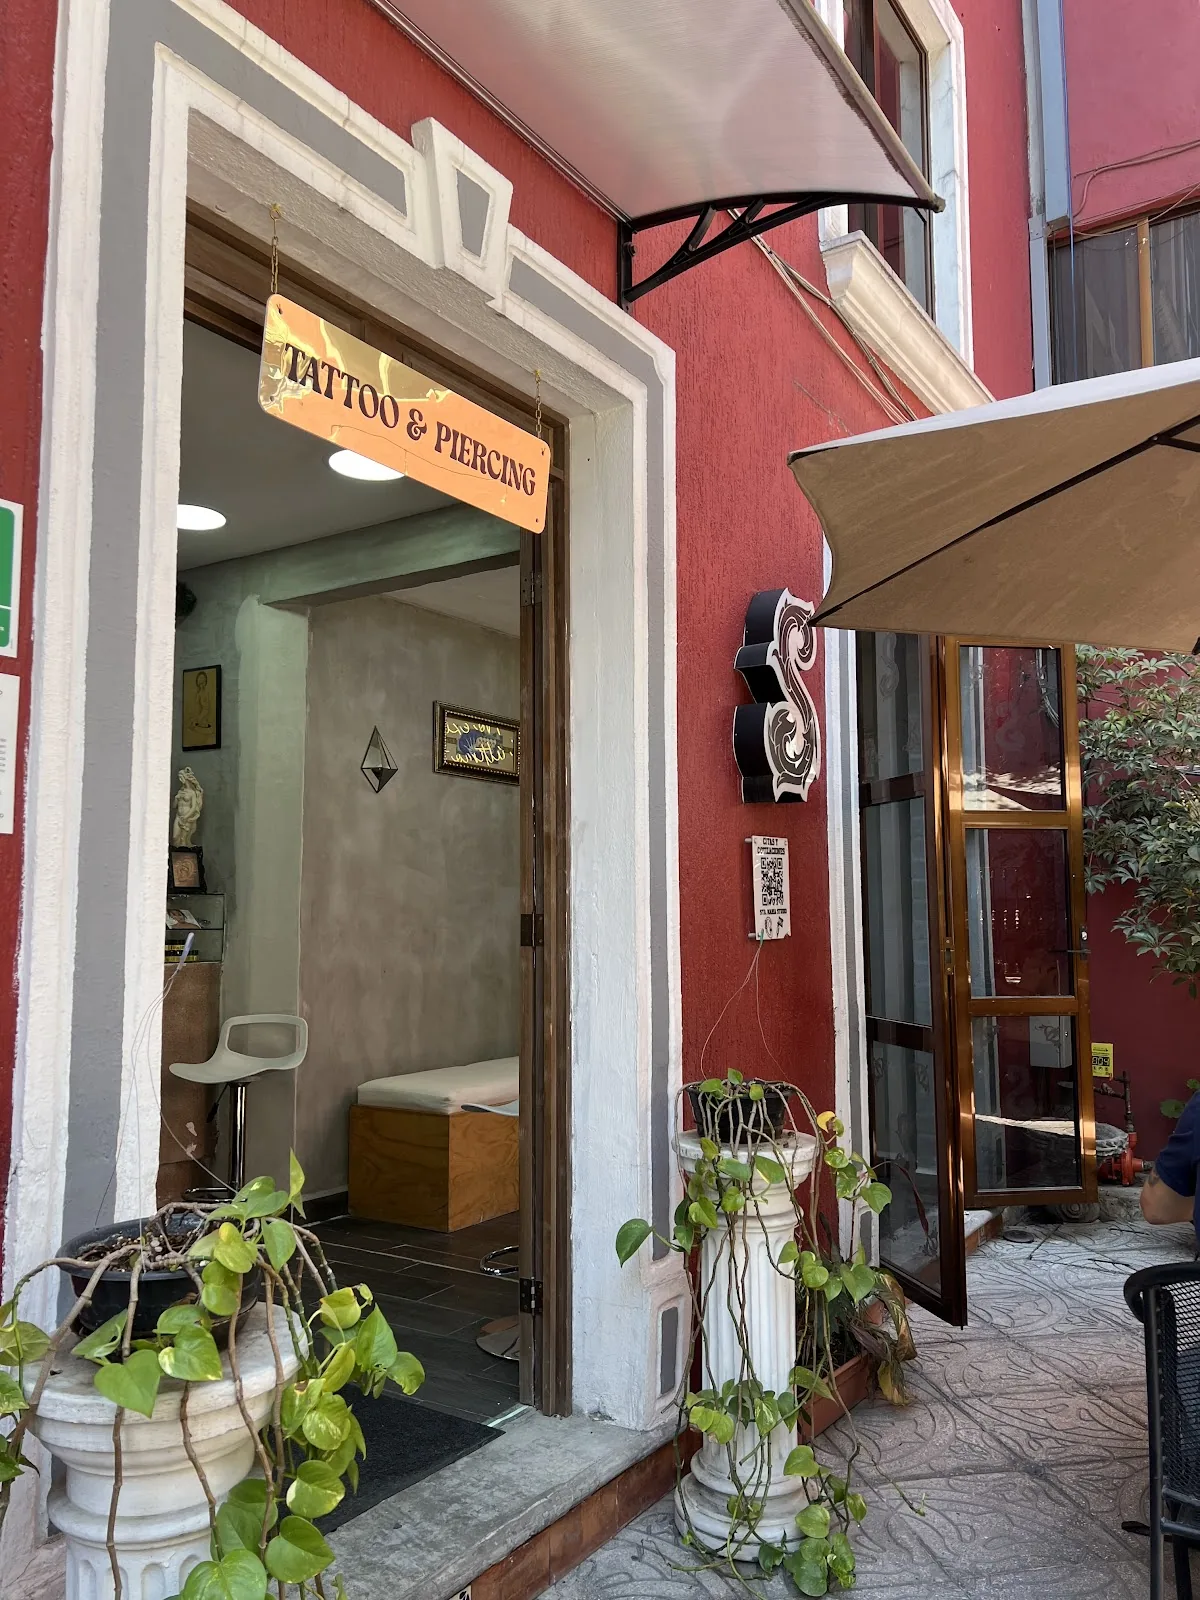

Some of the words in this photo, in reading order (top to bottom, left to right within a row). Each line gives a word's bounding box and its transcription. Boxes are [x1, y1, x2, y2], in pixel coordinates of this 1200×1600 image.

[285, 342, 400, 429] TATTOO
[406, 408, 428, 441] &
[434, 421, 536, 496] PIERCING
